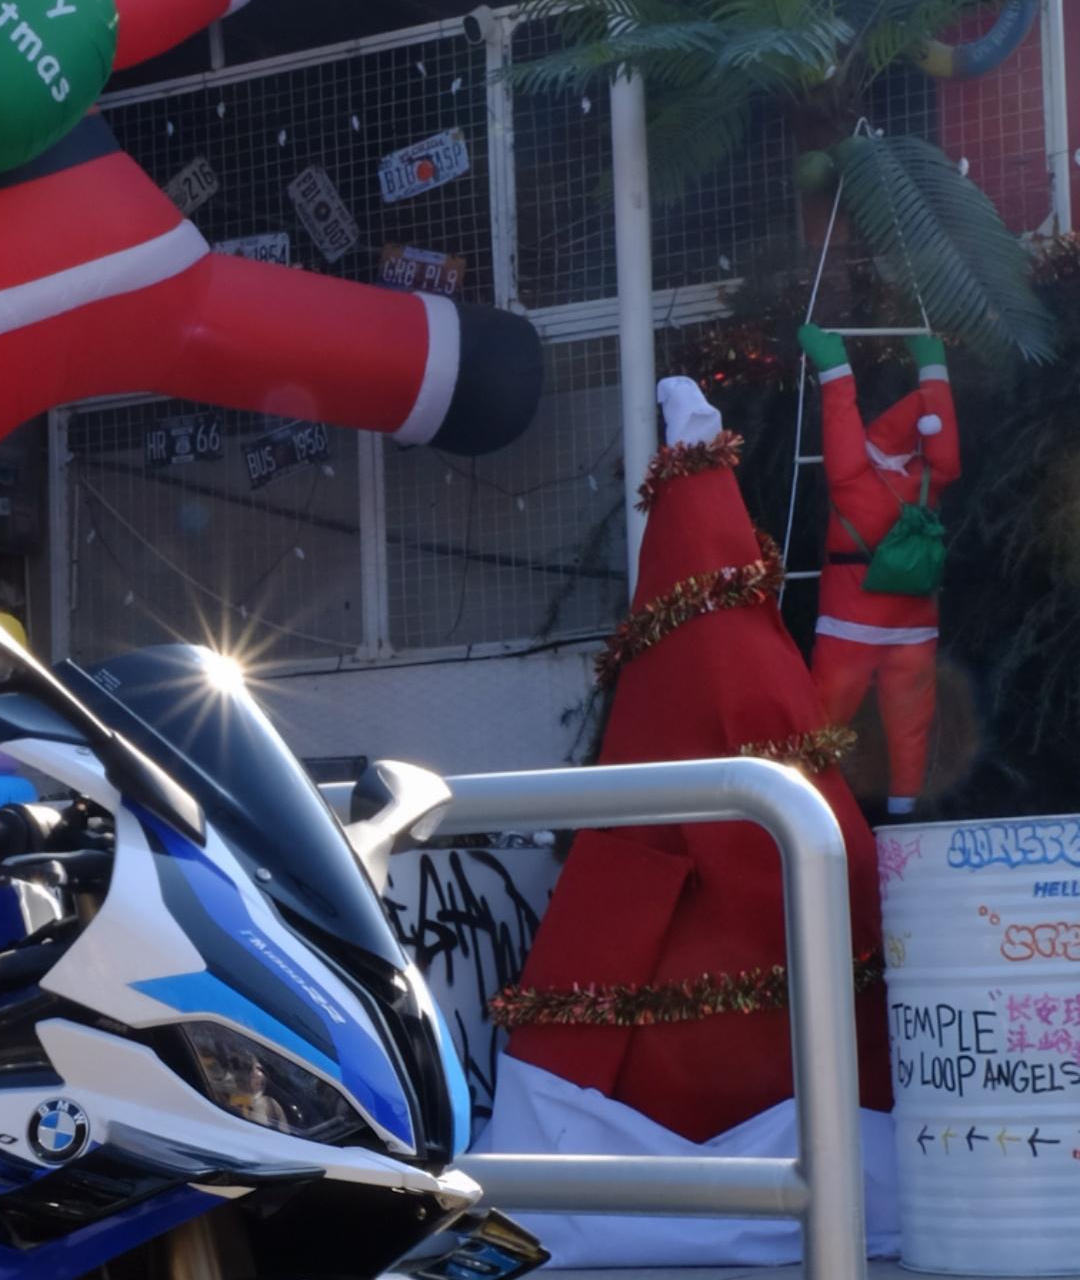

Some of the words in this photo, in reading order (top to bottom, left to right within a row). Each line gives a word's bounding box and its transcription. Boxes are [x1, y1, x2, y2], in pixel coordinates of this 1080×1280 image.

[196, 422, 221, 453] 66
[246, 446, 277, 480] BUS
[891, 1003, 998, 1054] TEMPLE
[897, 1046, 914, 1088] by
[920, 1051, 976, 1097] LOOP
[983, 1057, 1080, 1094] ANGELS
[38, 1099, 88, 1125] BMW
